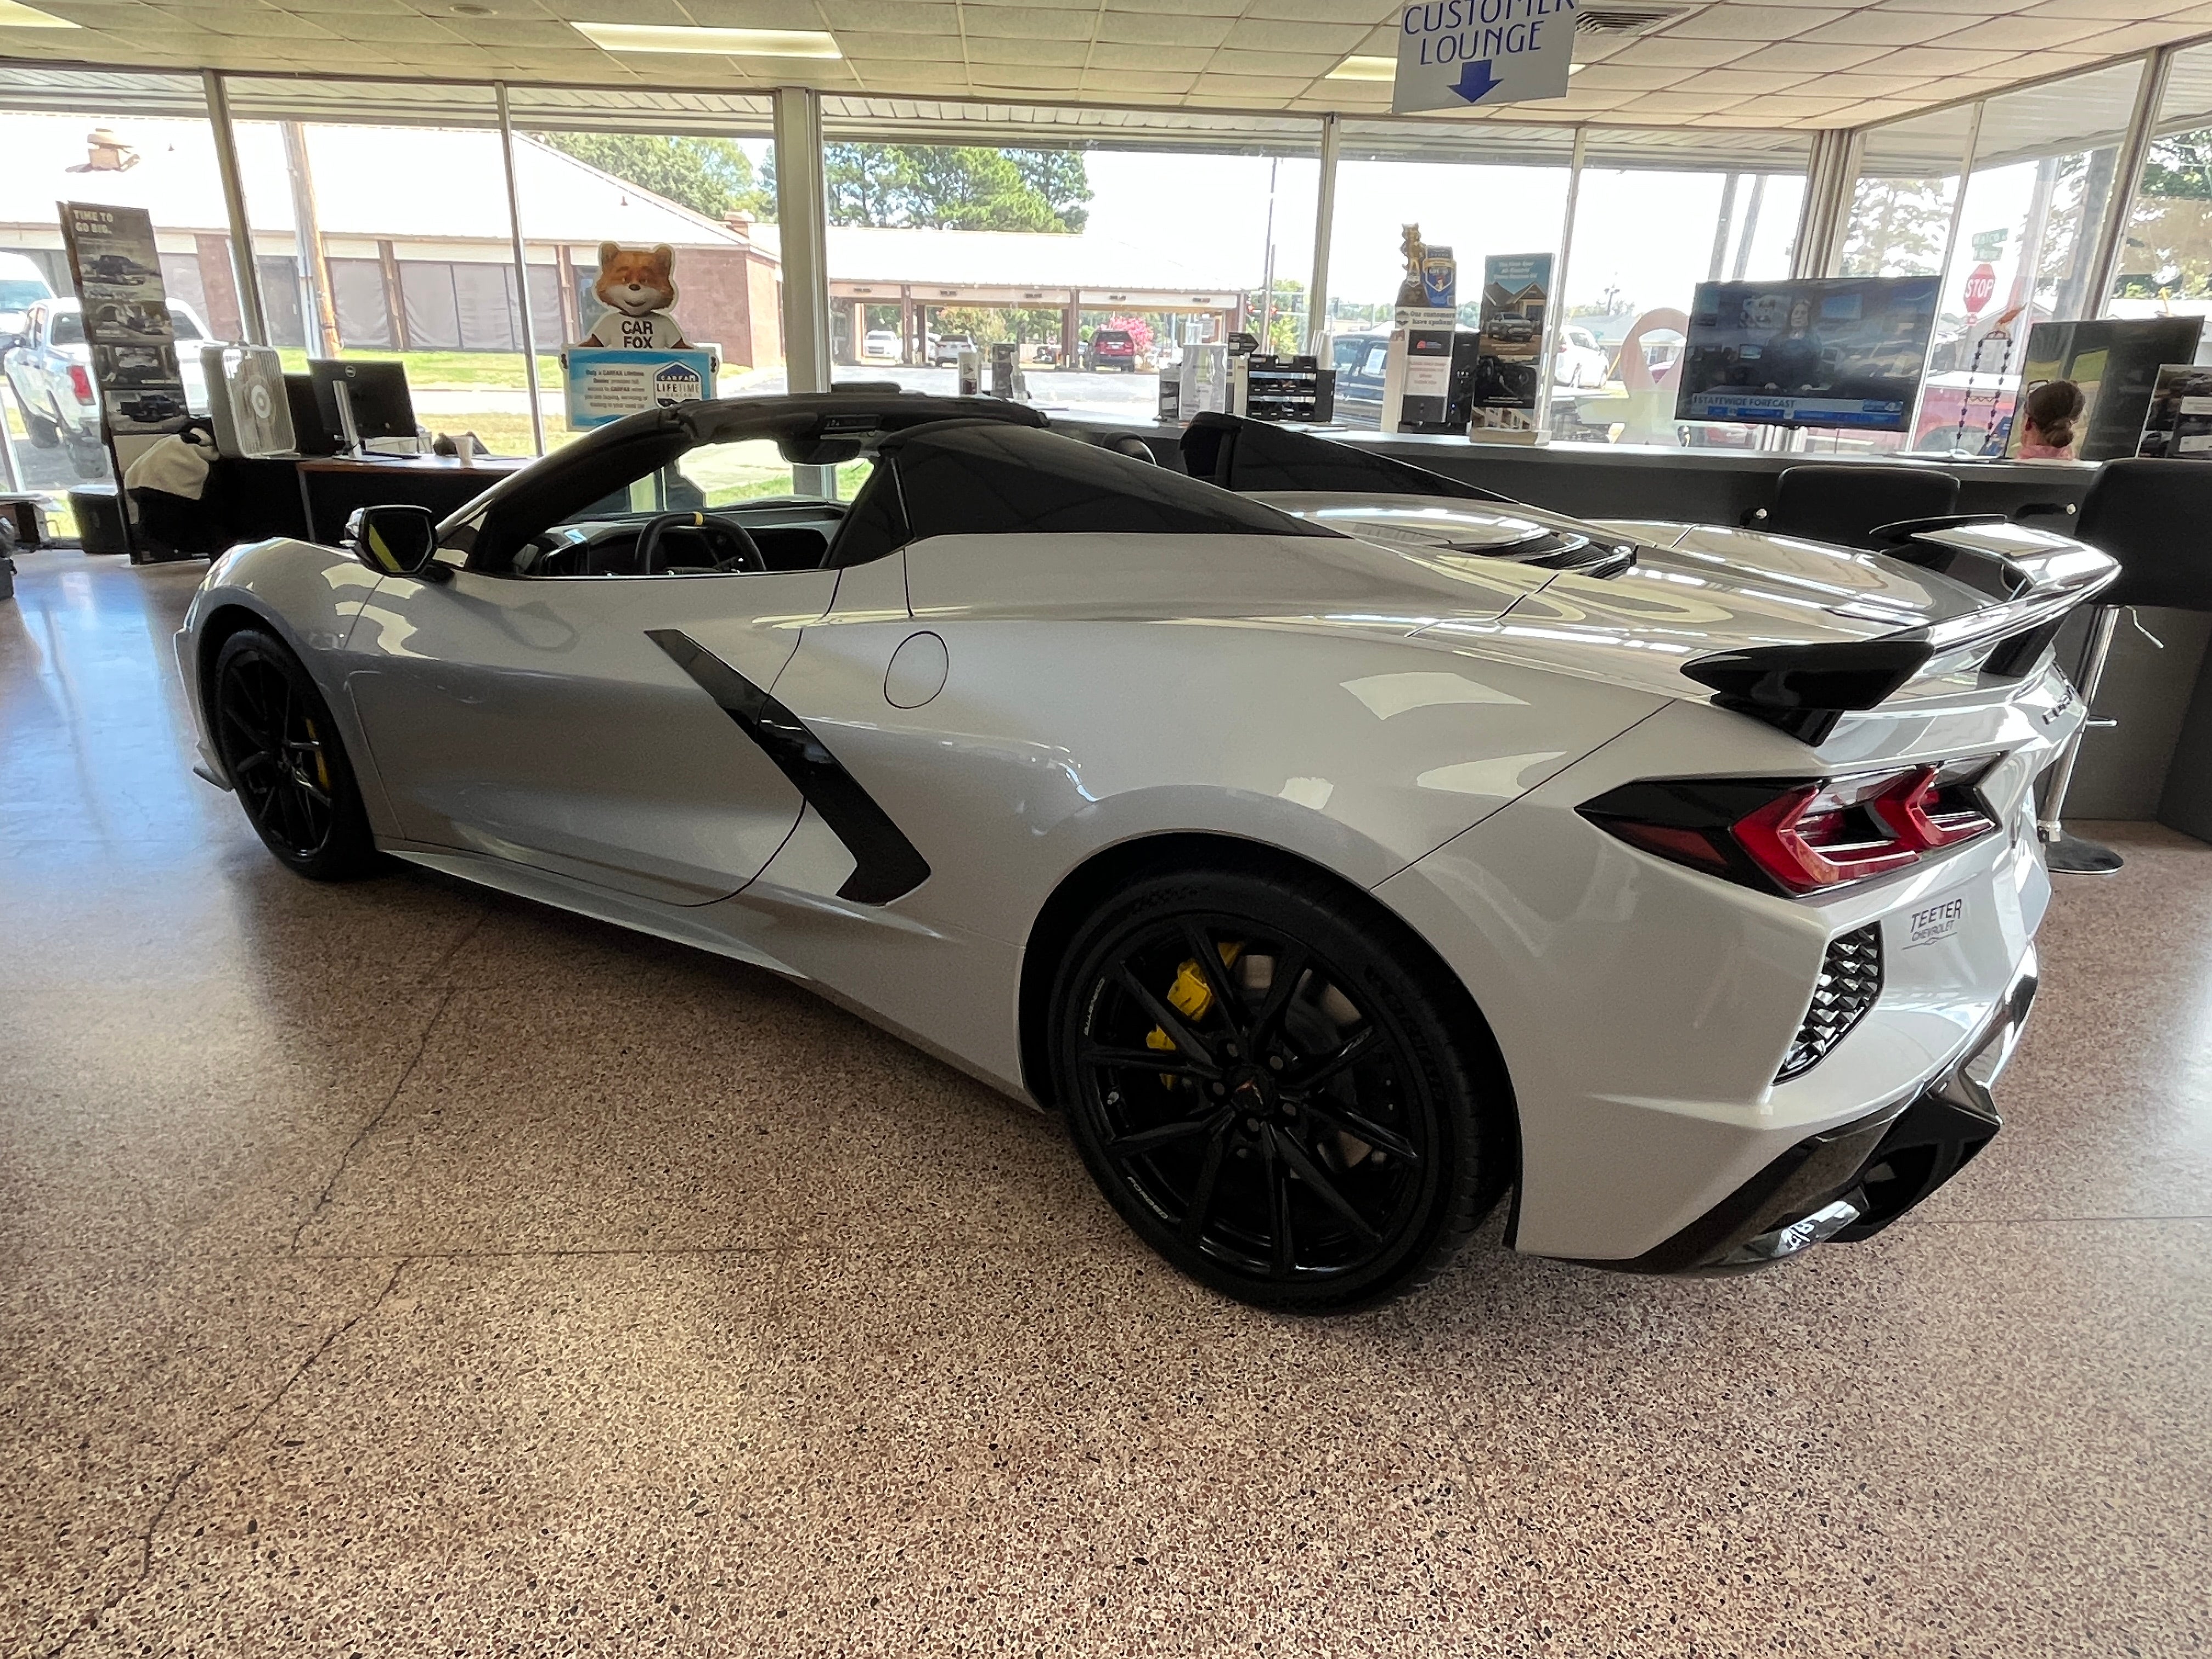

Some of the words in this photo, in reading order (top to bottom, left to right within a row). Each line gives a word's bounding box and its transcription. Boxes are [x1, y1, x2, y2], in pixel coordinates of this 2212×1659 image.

[1420, 20, 1544, 65] LOUNGE
[73, 209, 98, 222] TIME
[100, 212, 114, 223] TO
[75, 222, 89, 232] GO
[1965, 278, 1994, 298] STOP
[621, 320, 653, 335] CAR
[623, 335, 653, 349] FOX
[656, 383, 700, 393] LIFETIME
[1698, 396, 1747, 406] STATEWIDE
[1749, 398, 1797, 408] FORECAST
[1910, 898, 1962, 934] TEETER
